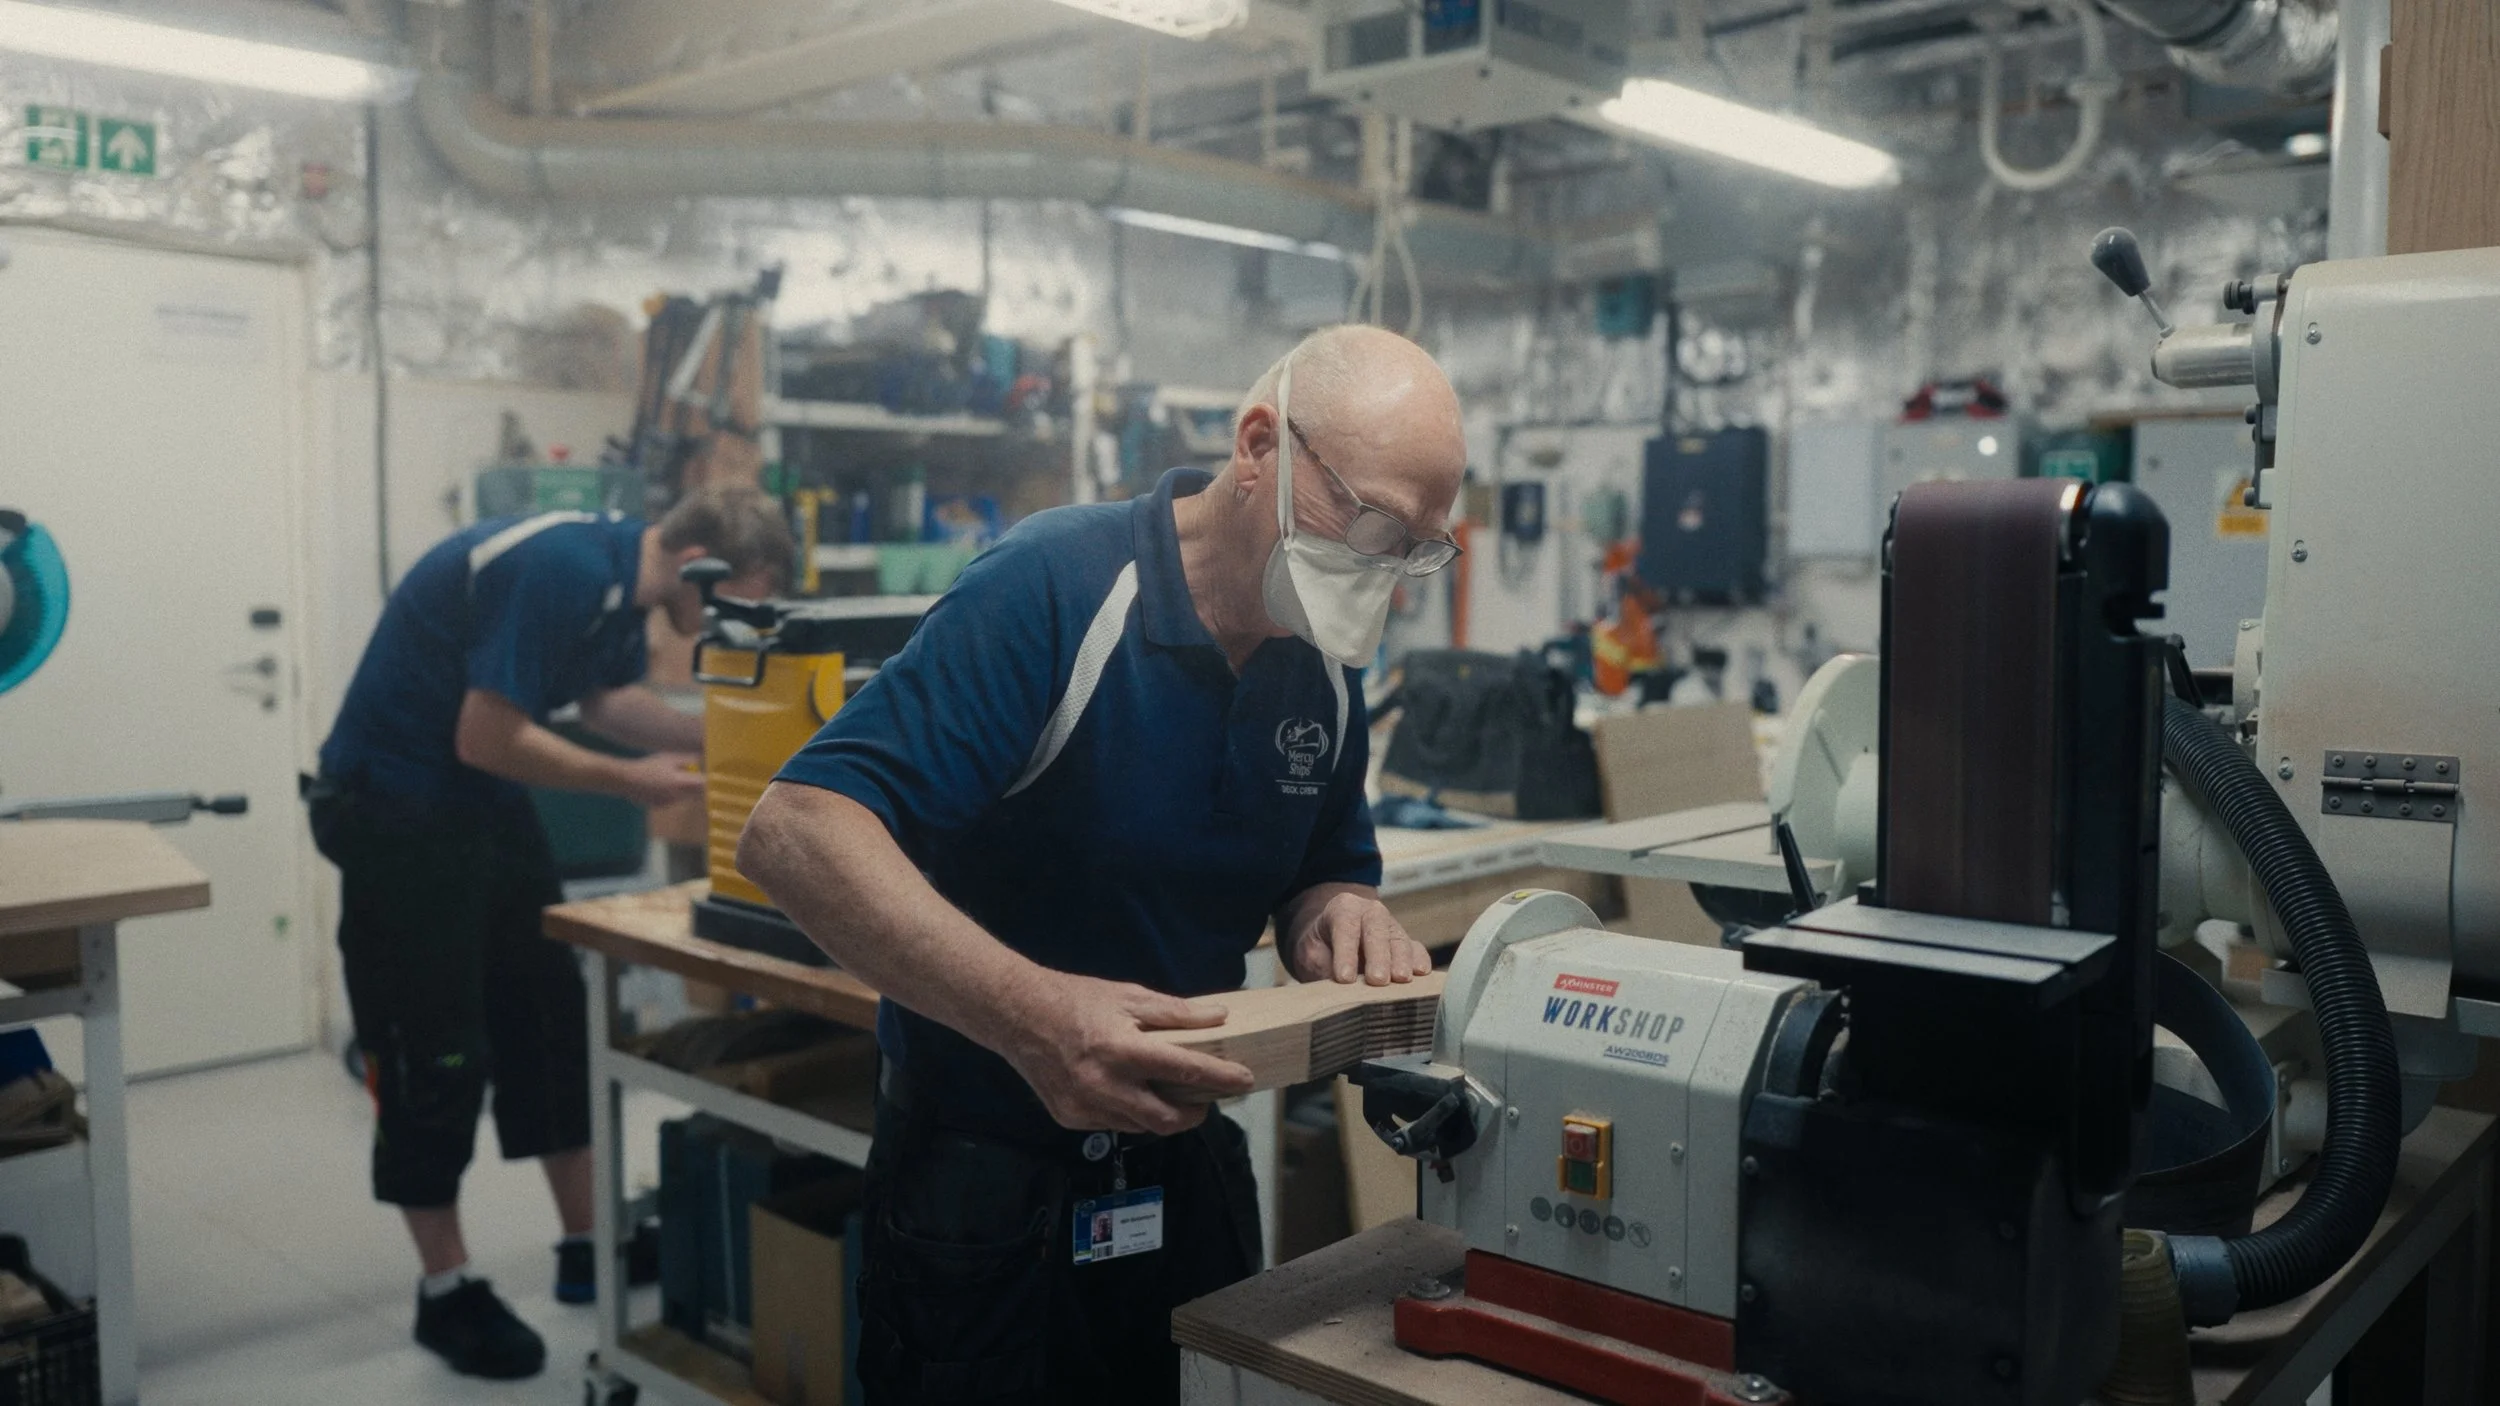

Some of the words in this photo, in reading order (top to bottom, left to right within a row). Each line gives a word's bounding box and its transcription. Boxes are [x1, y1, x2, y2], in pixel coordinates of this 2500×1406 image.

[1288, 750, 1314, 767] Mercy
[1289, 763, 1311, 778] Ships
[1559, 977, 1614, 993] AXMINSTER
[1542, 996, 1685, 1044] WORKSHOP
